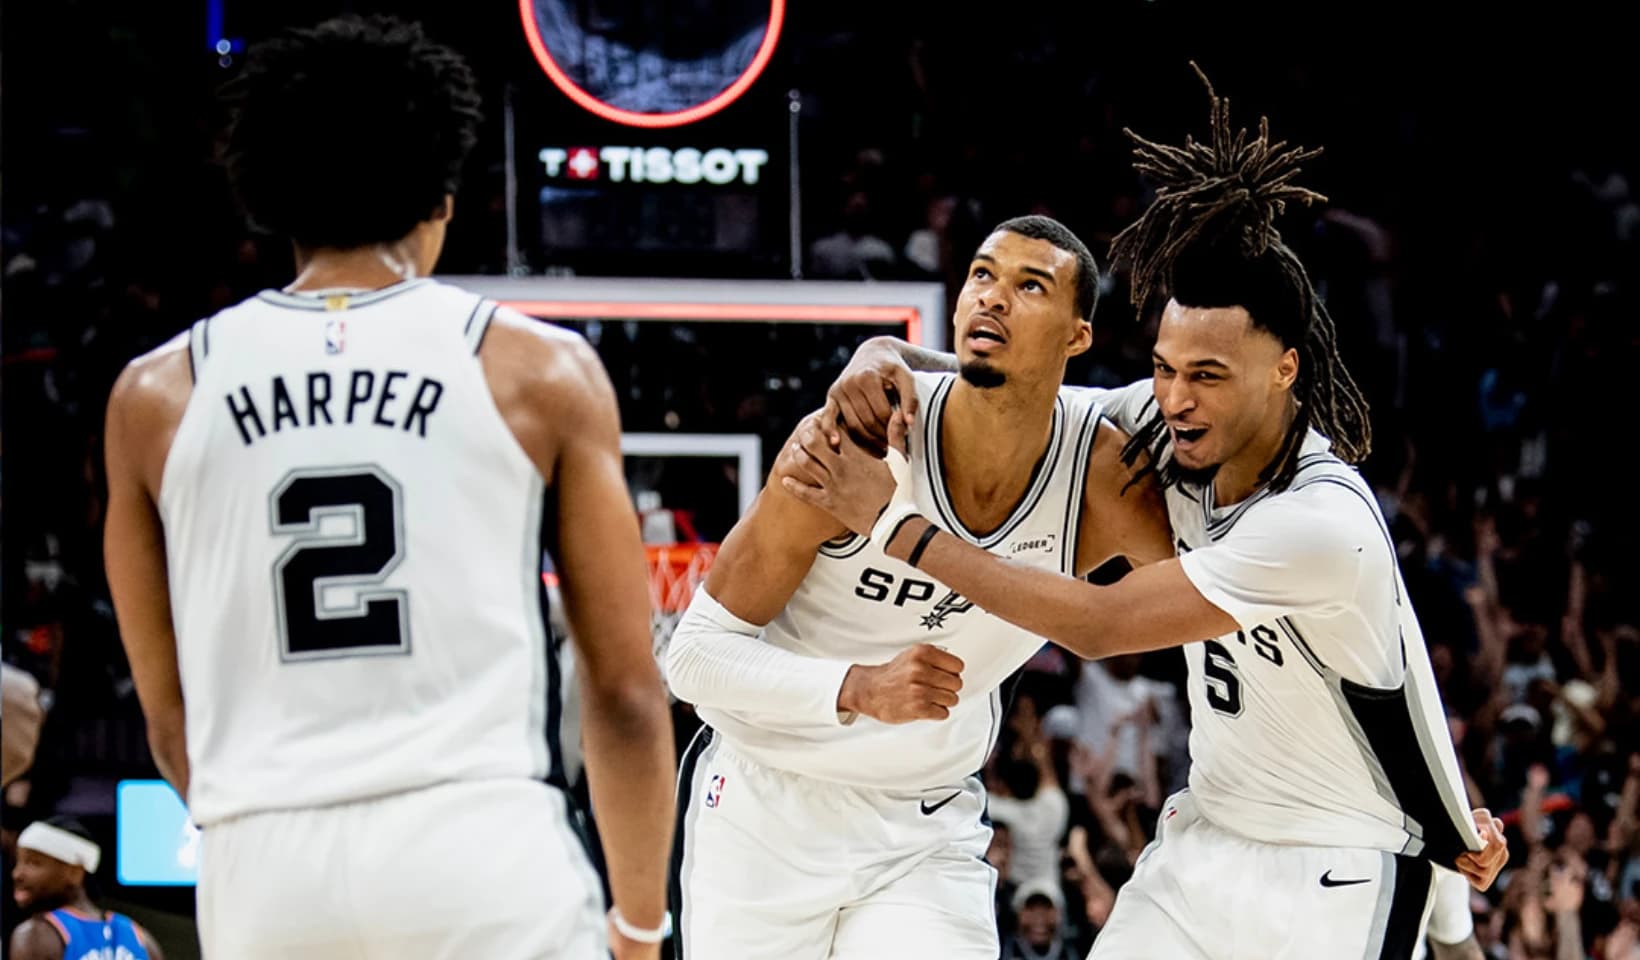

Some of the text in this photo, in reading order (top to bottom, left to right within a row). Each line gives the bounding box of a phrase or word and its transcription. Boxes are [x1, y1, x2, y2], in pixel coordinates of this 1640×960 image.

[600, 147, 768, 184] TISSOT
[226, 370, 443, 446] HARPER
[269, 464, 411, 663] 2
